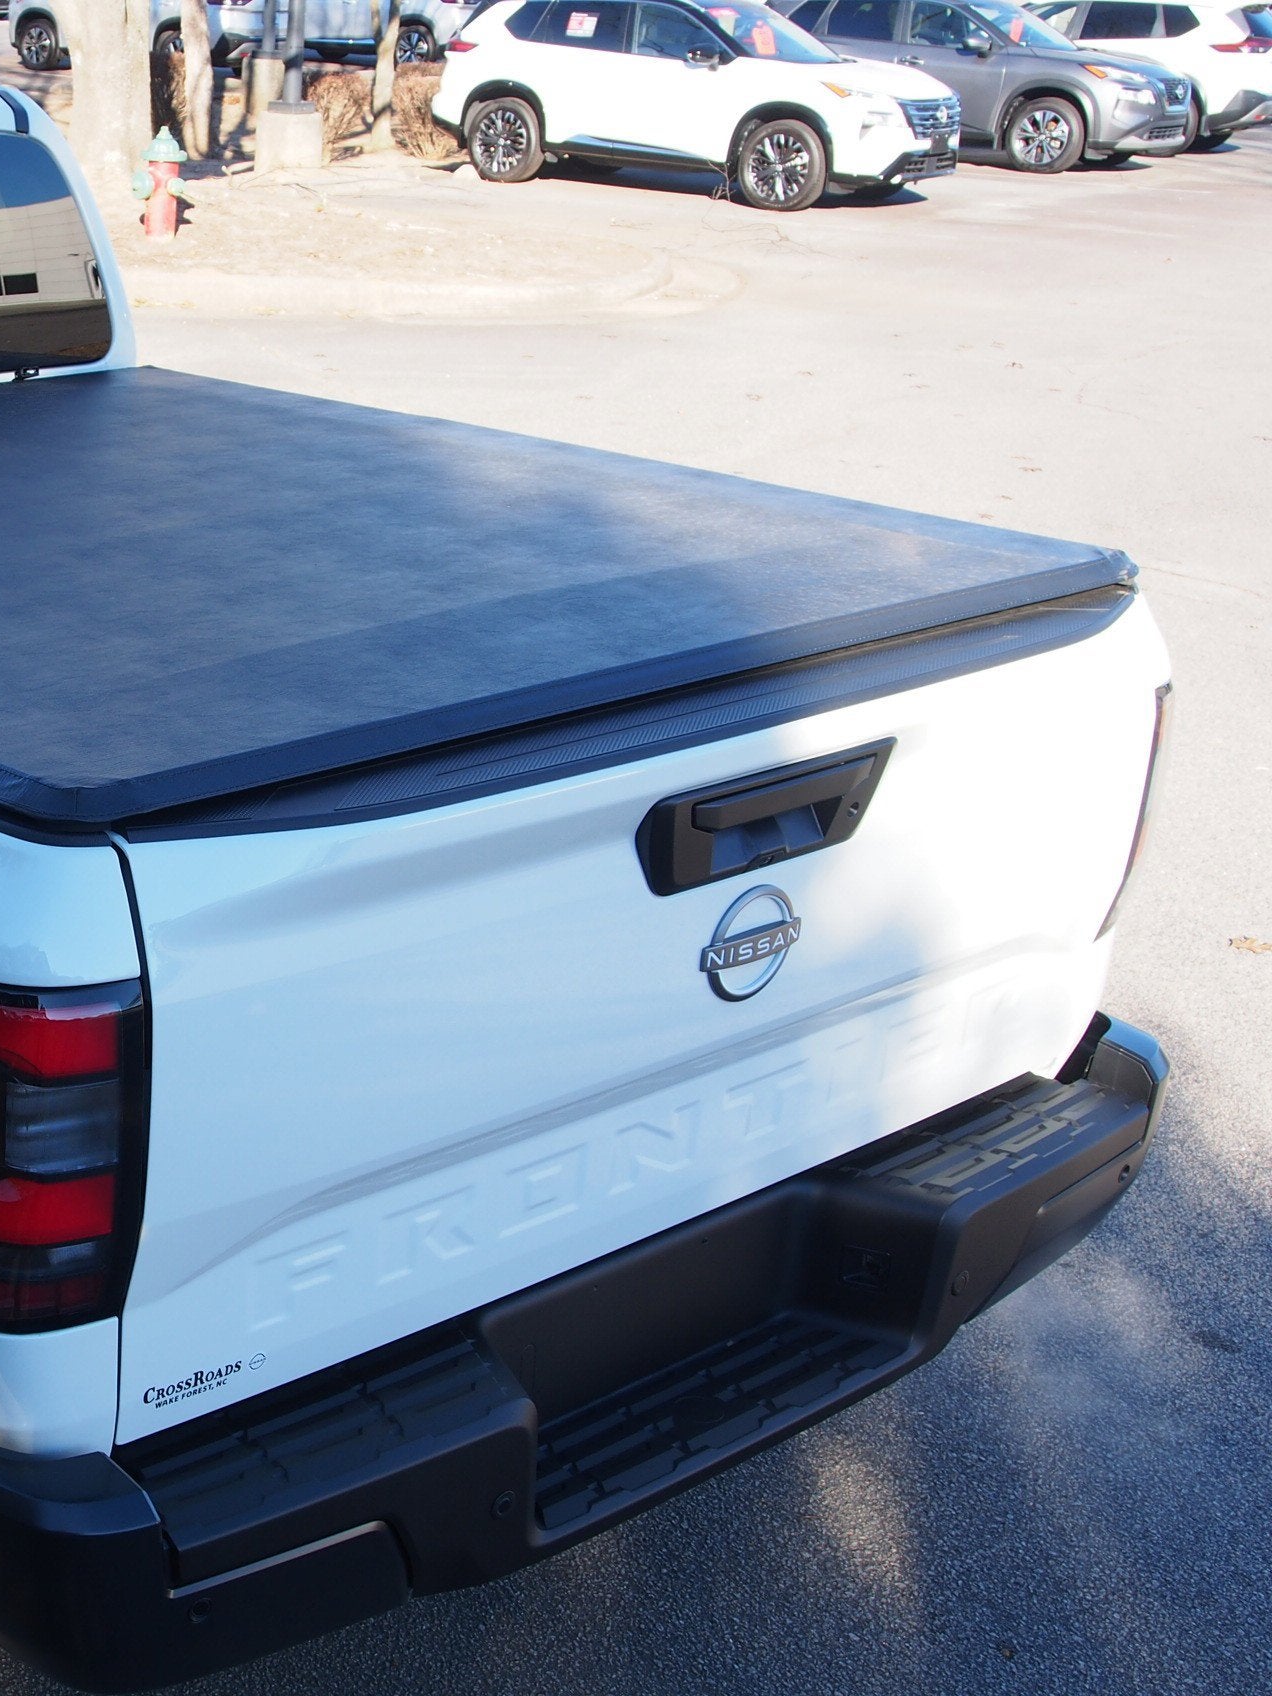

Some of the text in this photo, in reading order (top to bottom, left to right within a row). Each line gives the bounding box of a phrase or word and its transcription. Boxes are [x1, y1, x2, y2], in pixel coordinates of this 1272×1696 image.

[706, 923, 800, 968] NISSAN
[247, 973, 1028, 1335] FRONTIER
[155, 1379, 228, 1409] WAKE FOREST, NC
